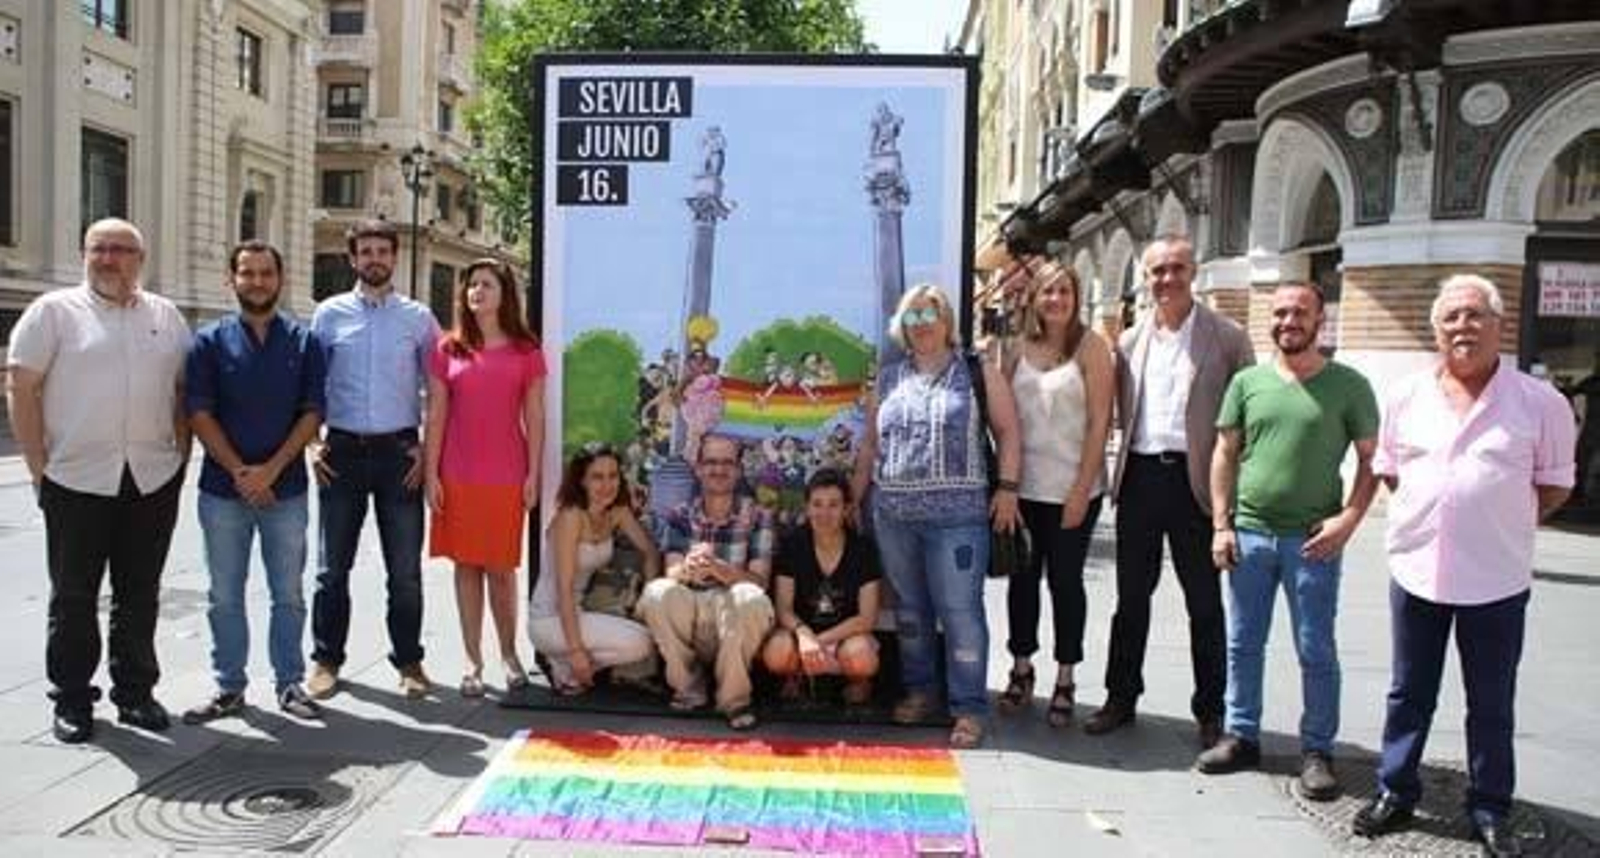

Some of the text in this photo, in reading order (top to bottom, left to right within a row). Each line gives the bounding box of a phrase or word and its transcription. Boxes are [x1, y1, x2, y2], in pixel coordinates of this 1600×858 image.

[579, 81, 681, 113] SEVILLA
[577, 125, 660, 158] JUNIO
[577, 168, 618, 201] 16.
